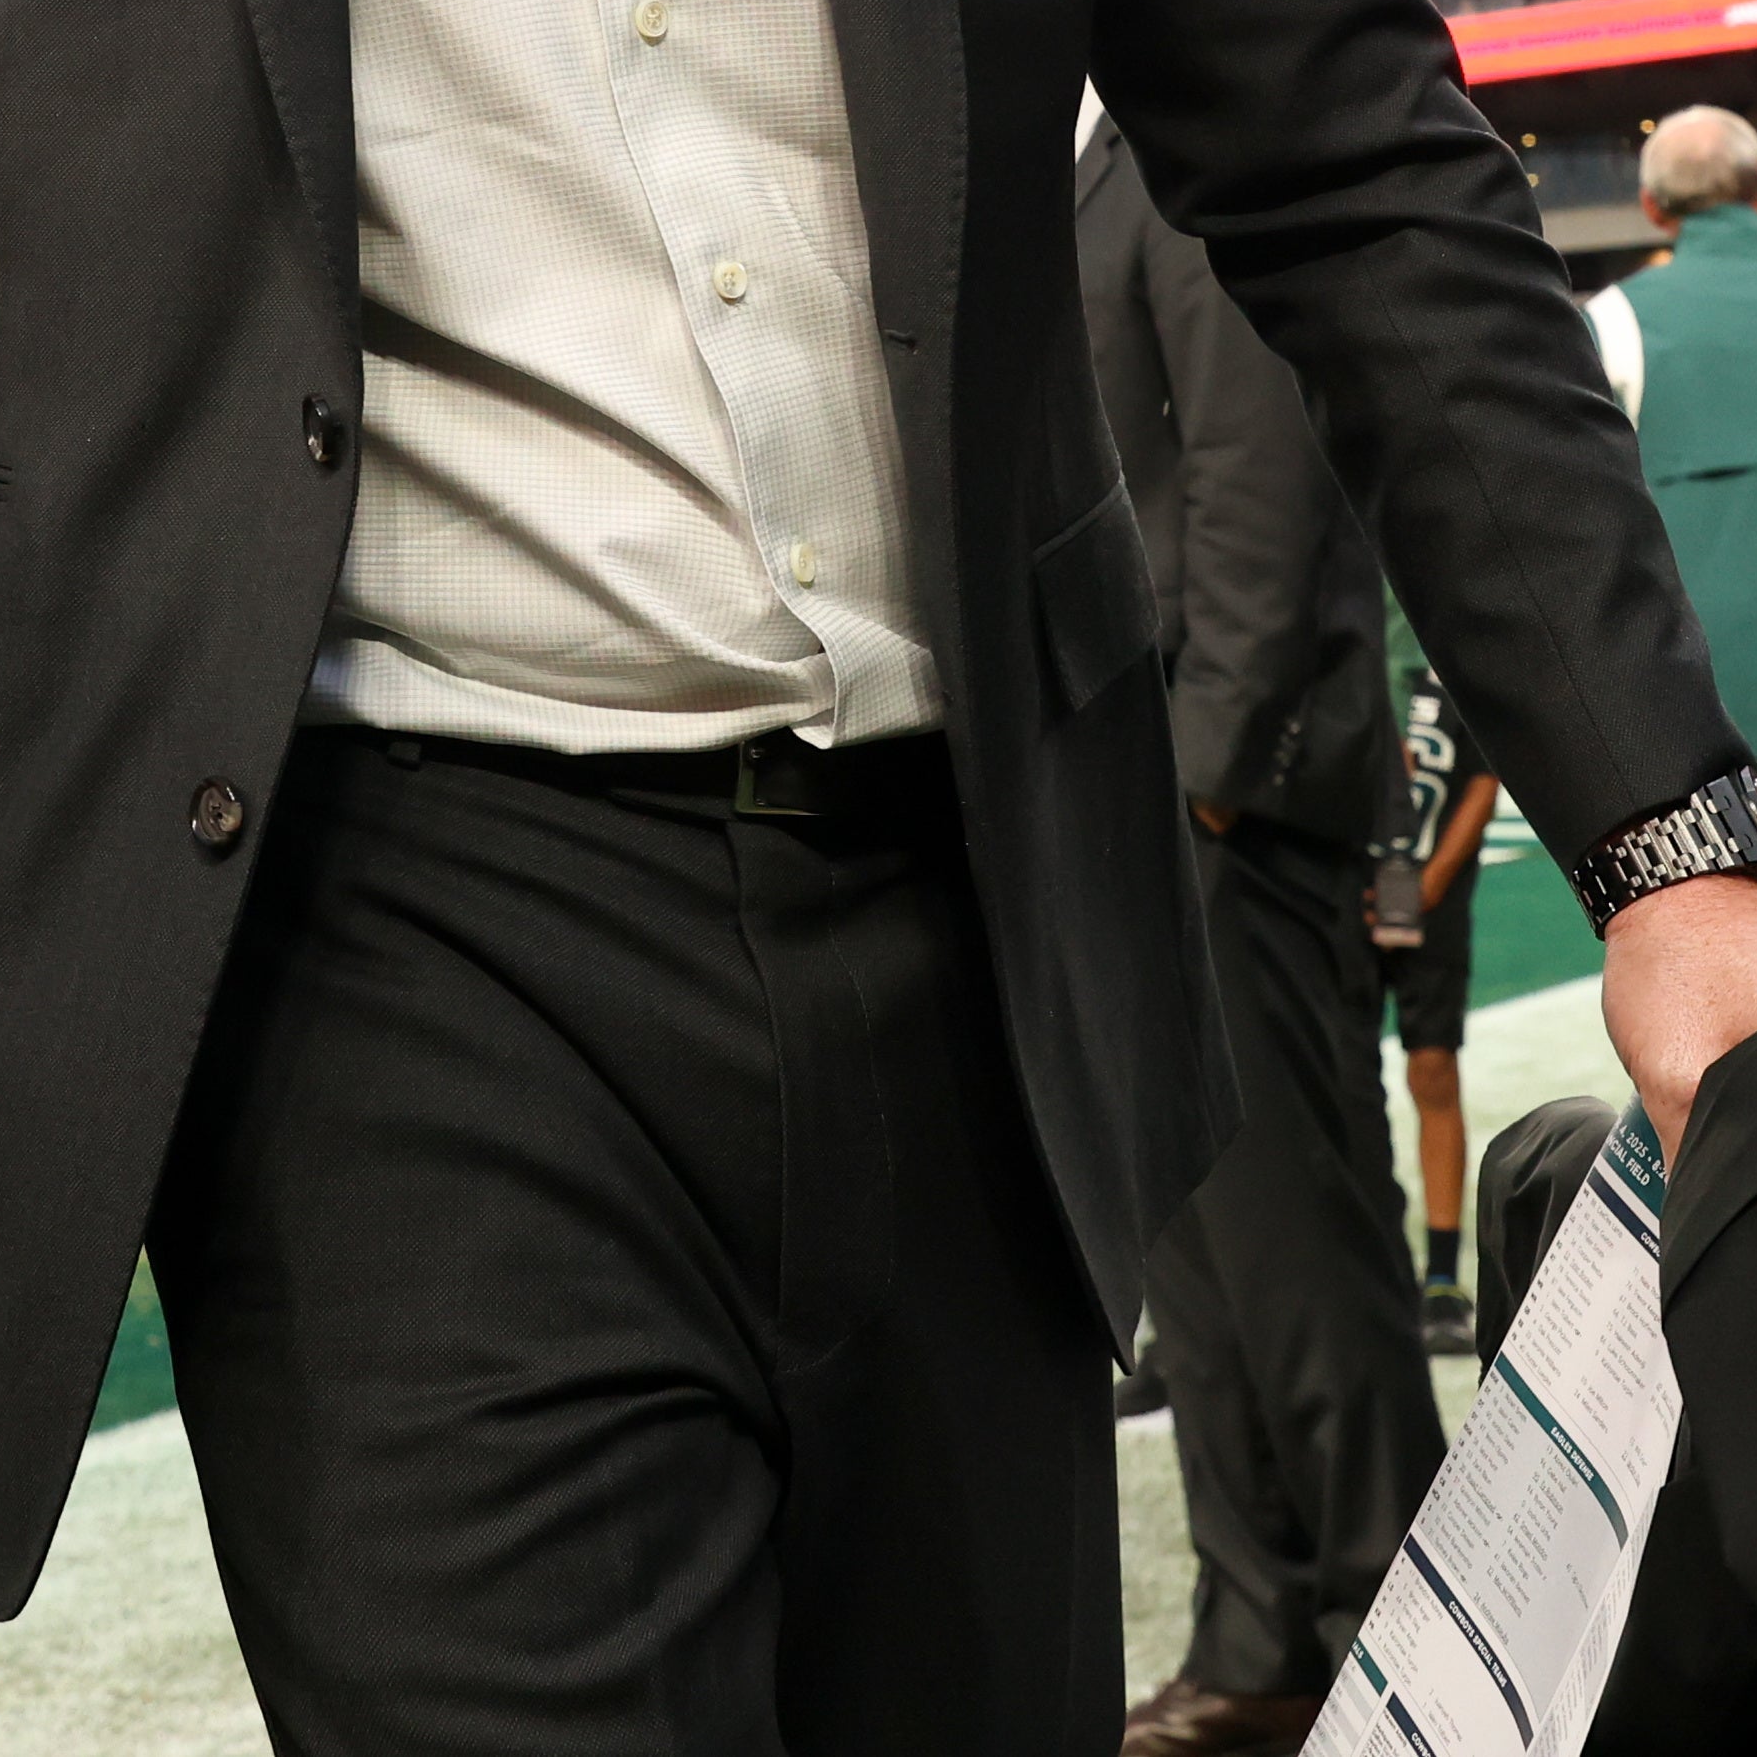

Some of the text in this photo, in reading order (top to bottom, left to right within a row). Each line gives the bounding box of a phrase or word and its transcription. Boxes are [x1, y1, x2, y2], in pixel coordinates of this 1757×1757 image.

[1626, 1132, 1649, 1158] 2025
[1625, 1157, 1650, 1186] FIELD
[1551, 1427, 1594, 1481] EAGLES DEFENSE
[1449, 1601, 1475, 1637] COWBOYS
[1467, 1635, 1493, 1665] SPECIAL
[1485, 1662, 1507, 1687] TEAMS
